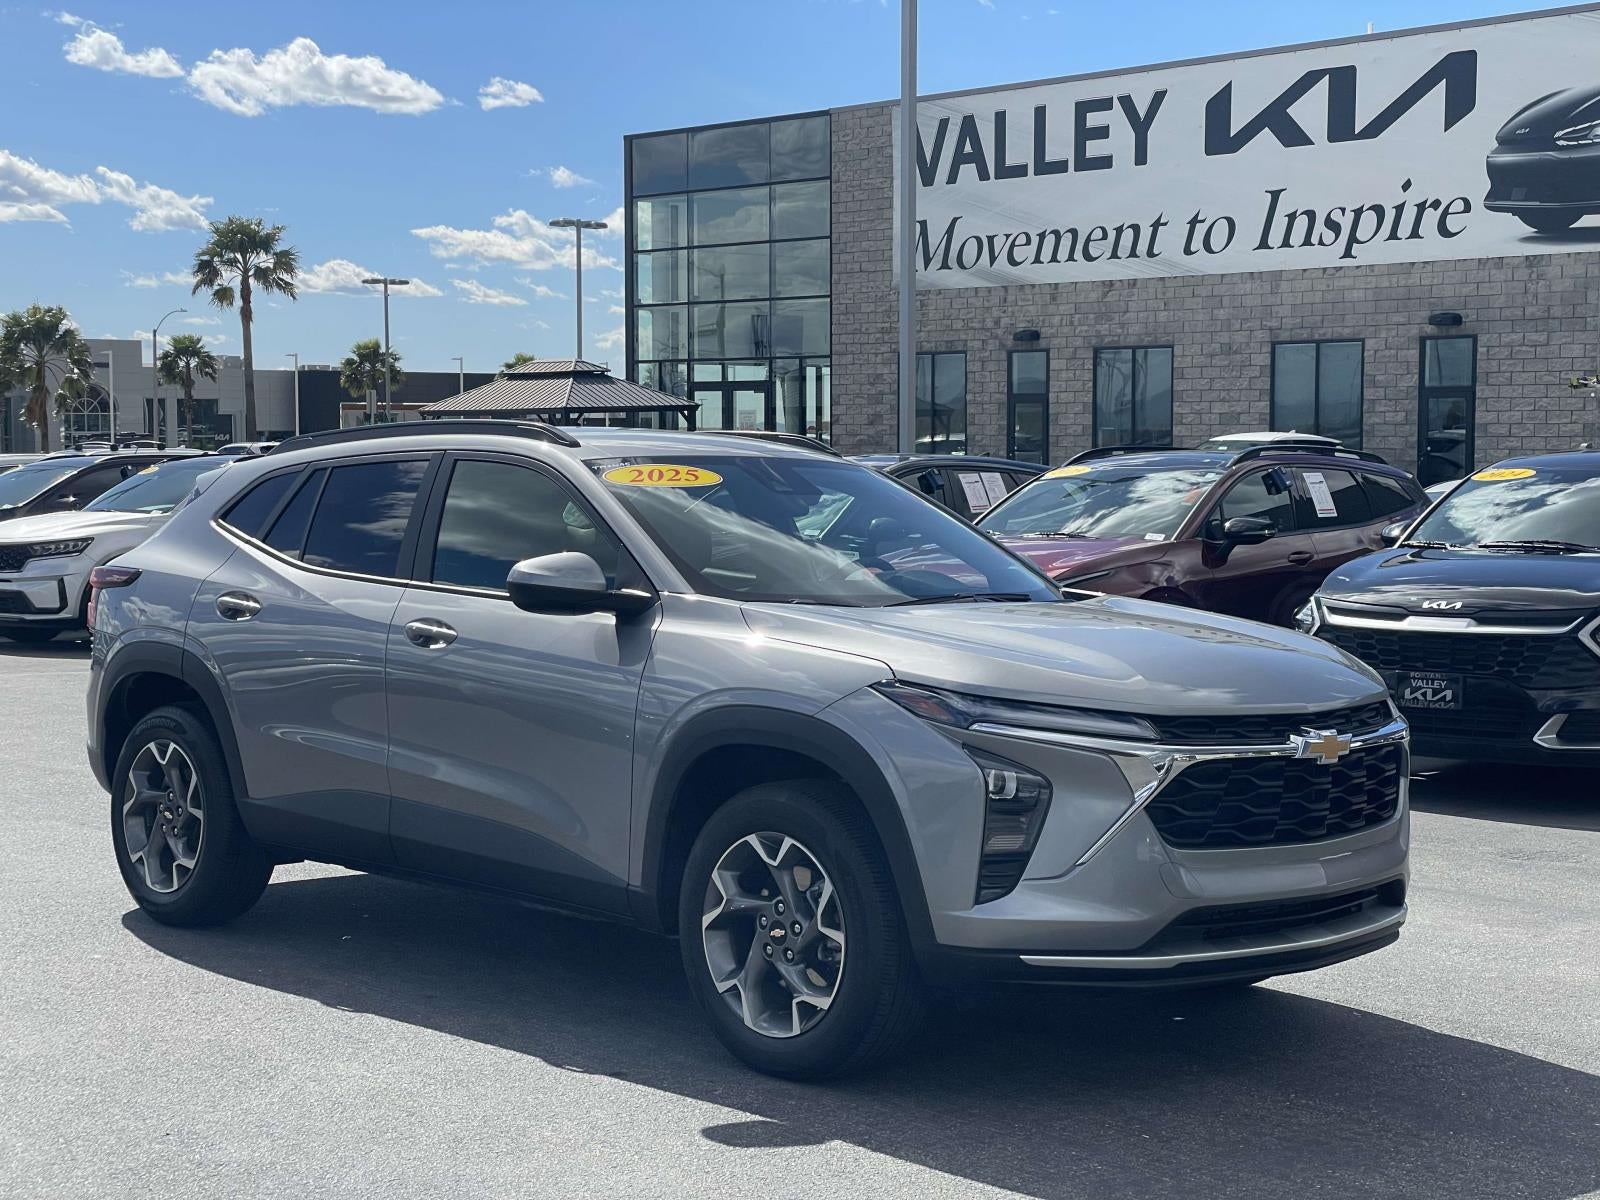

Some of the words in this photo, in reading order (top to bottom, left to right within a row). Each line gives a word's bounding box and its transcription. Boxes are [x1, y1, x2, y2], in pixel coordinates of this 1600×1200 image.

[916, 88, 1168, 188] VALLEY
[916, 210, 1169, 274] Movement
[1182, 207, 1236, 256] to
[1252, 177, 1473, 260] Inspire
[628, 468, 700, 483] 2025
[1410, 679, 1447, 688] VALLEY
